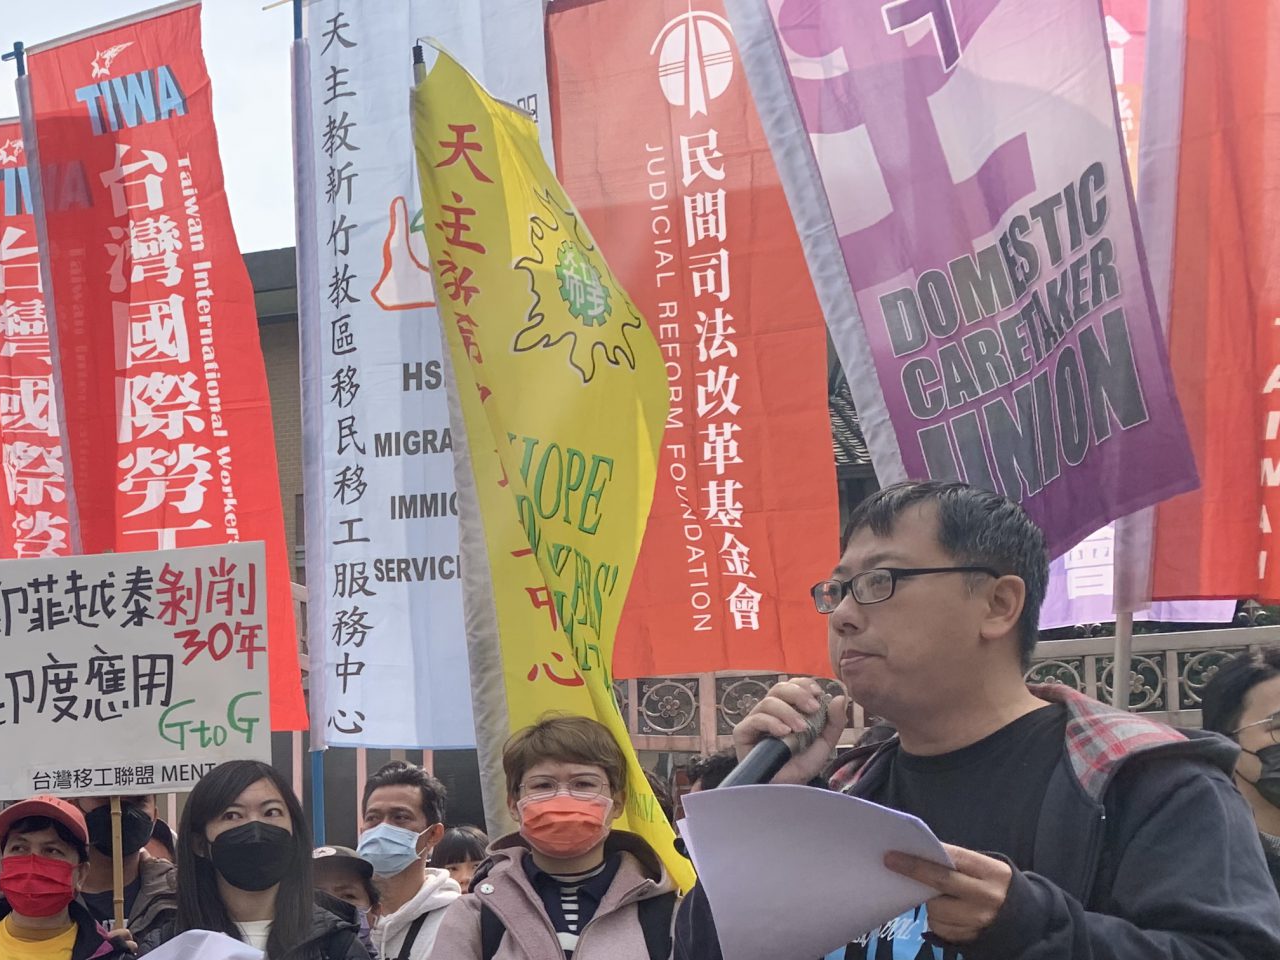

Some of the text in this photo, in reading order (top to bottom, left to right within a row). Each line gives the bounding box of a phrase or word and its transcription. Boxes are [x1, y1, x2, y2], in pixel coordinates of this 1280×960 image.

[75, 64, 189, 137] TIWA
[177, 152, 206, 252] Taiwan
[192, 261, 229, 438] International
[877, 160, 1109, 358] DOMESTIC
[900, 237, 1121, 420] CARETAKER
[320, 12, 376, 736] 天主教新竹教區移民移工服務中心
[402, 360, 448, 392] HS
[646, 143, 713, 632] JUDICIAL REFORM FOUNDATION
[679, 128, 763, 631] 民間司法改革基金會
[916, 306, 1150, 503] UNION
[173, 621, 267, 670] 30年
[31, 762, 217, 791] 台灣移工聯盟 MENT
